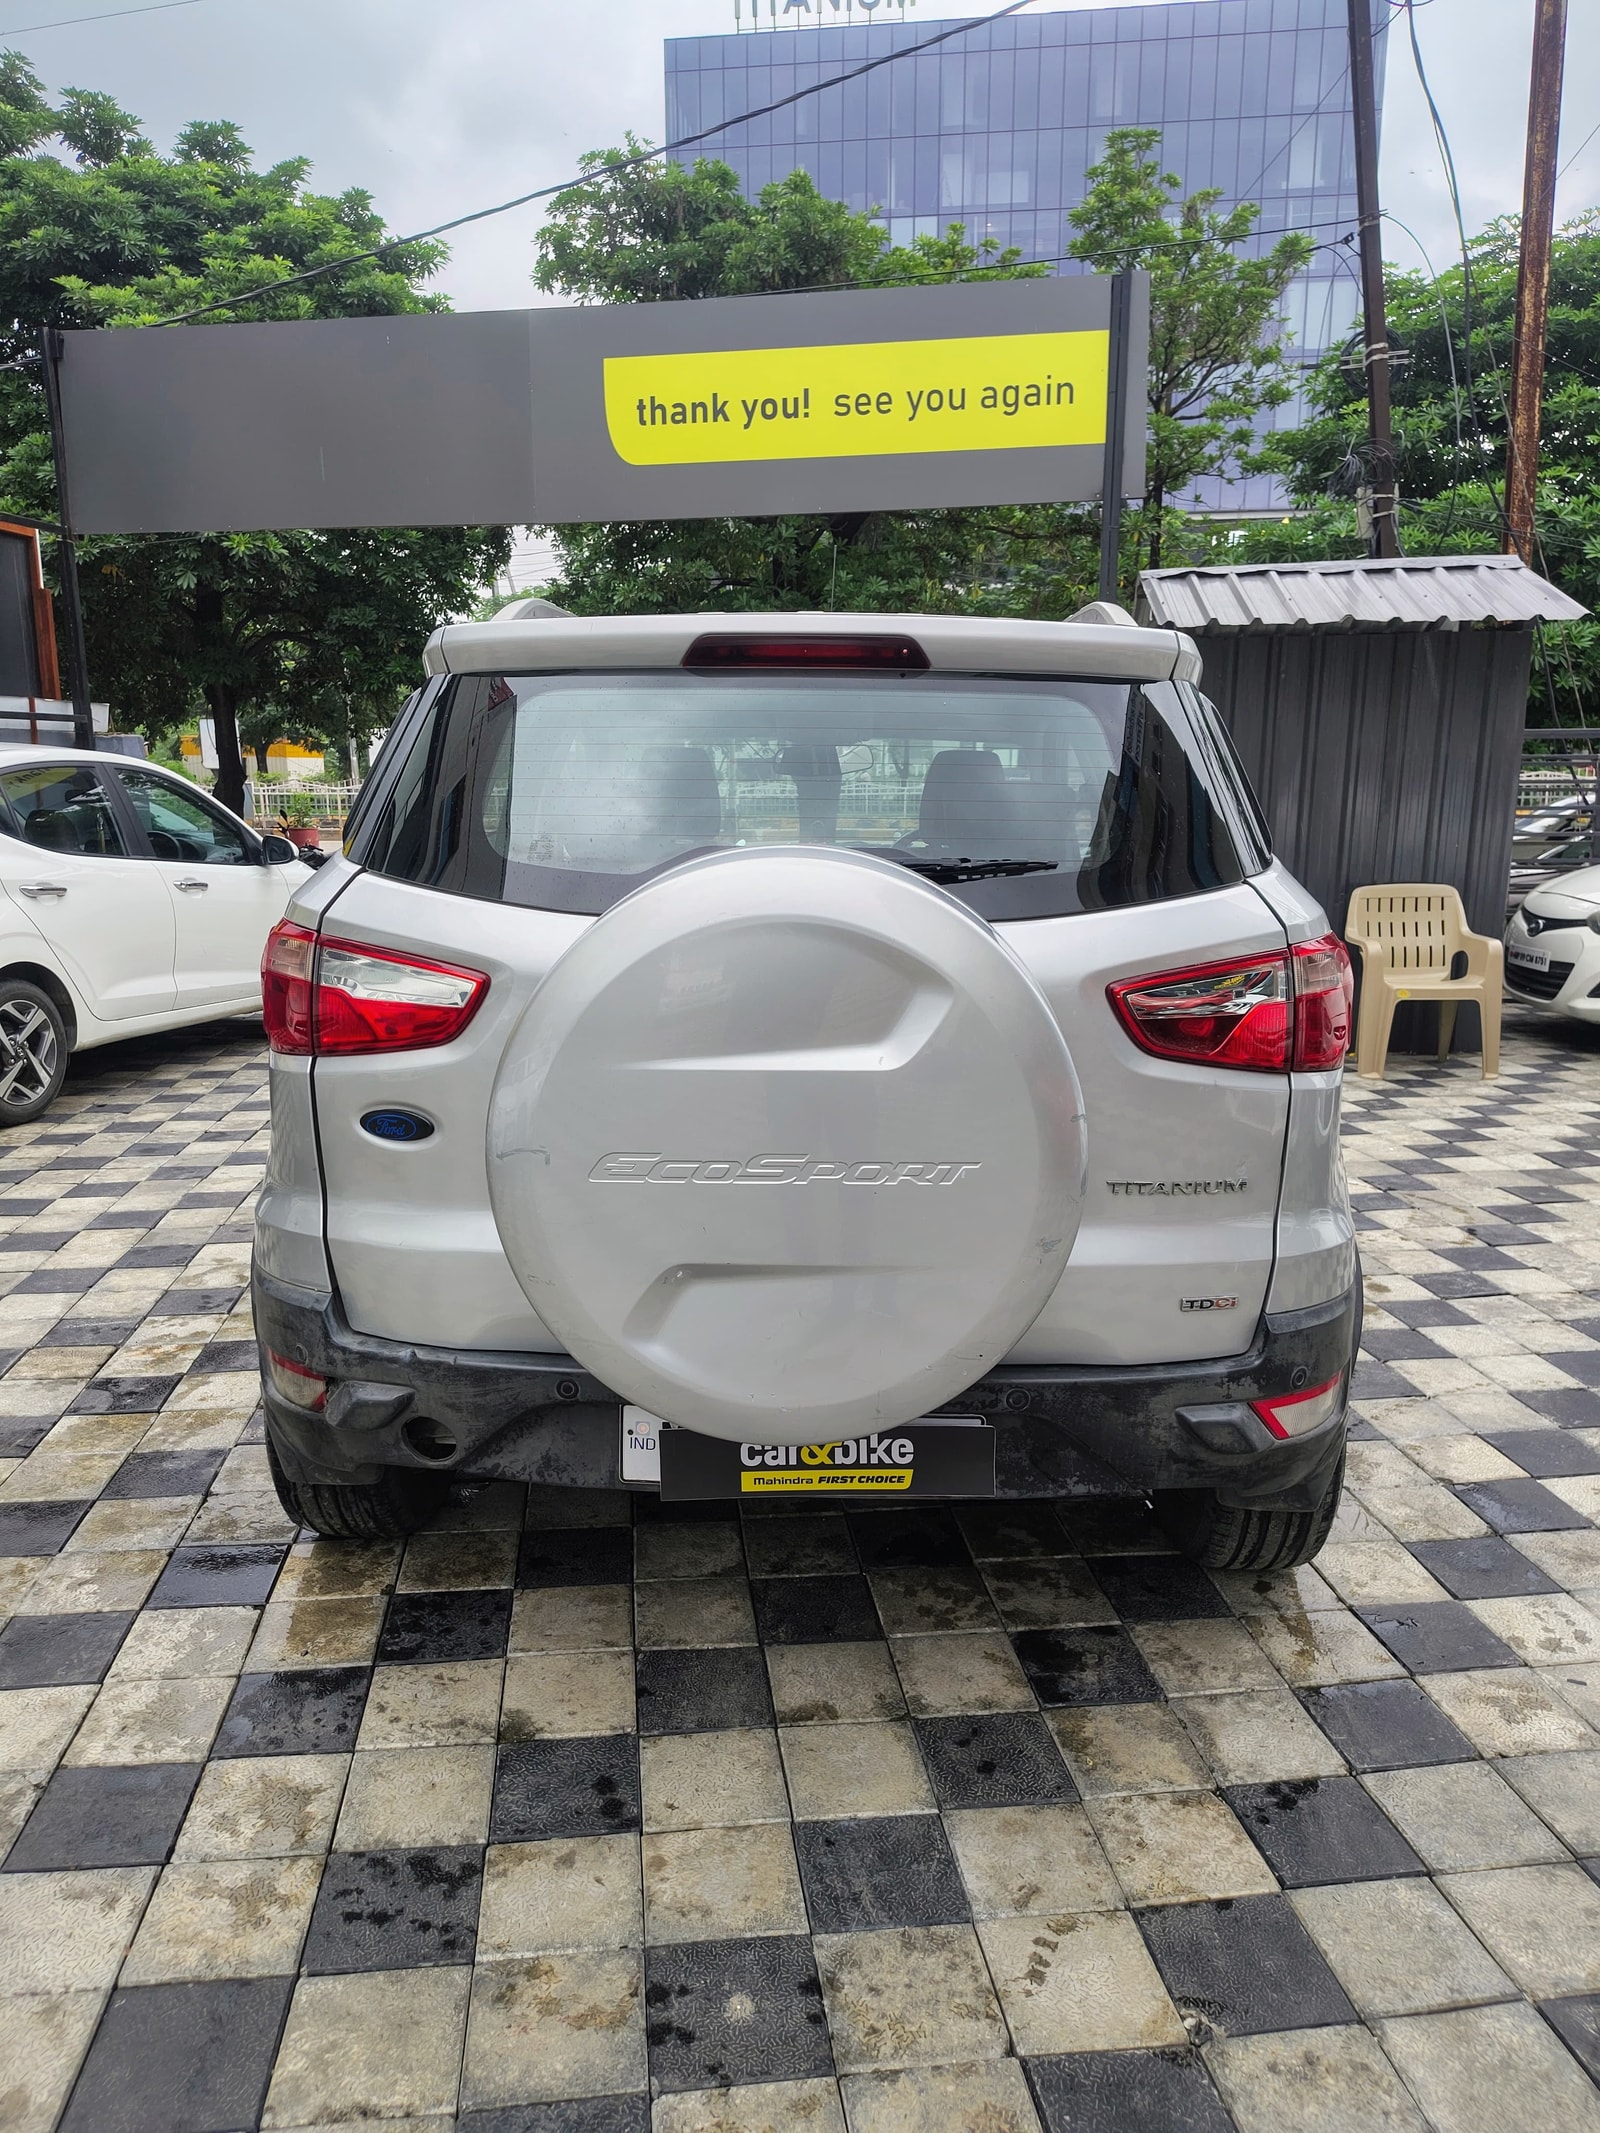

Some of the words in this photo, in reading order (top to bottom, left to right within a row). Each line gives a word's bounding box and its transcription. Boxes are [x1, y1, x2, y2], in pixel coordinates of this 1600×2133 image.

[636, 392, 730, 427] thank
[740, 387, 810, 430] you!
[833, 391, 893, 417] see
[906, 387, 967, 422] you
[980, 374, 1075, 417] again
[375, 1118, 406, 1136] Ford
[1106, 1178, 1248, 1196] TITANIUM
[629, 1436, 657, 1451] IND
[753, 1476, 813, 1486] Mahindra
[817, 1475, 857, 1484] FIRST
[857, 1475, 906, 1484] CHOICE
